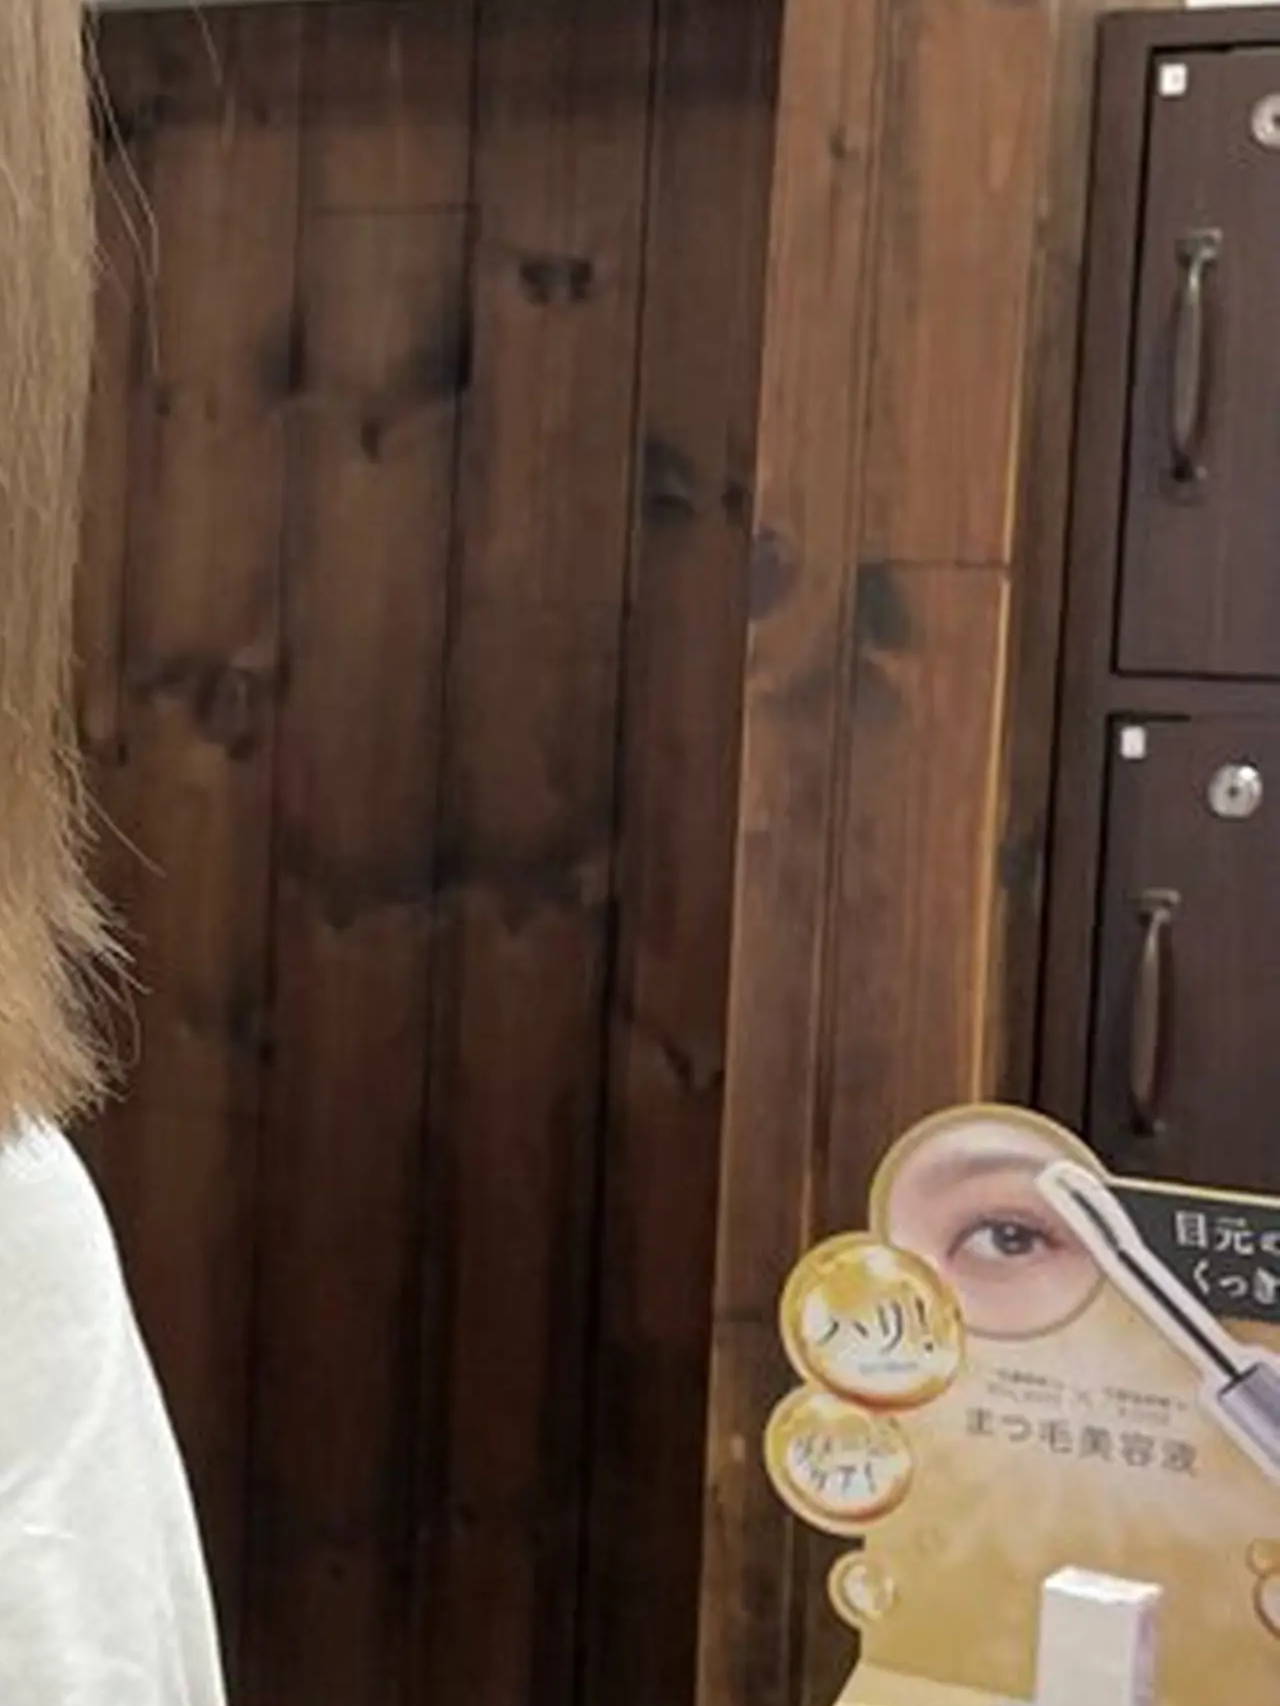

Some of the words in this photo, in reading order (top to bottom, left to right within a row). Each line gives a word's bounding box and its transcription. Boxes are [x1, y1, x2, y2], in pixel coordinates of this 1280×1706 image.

[965, 1405, 1199, 1478] まつ毛美容液
